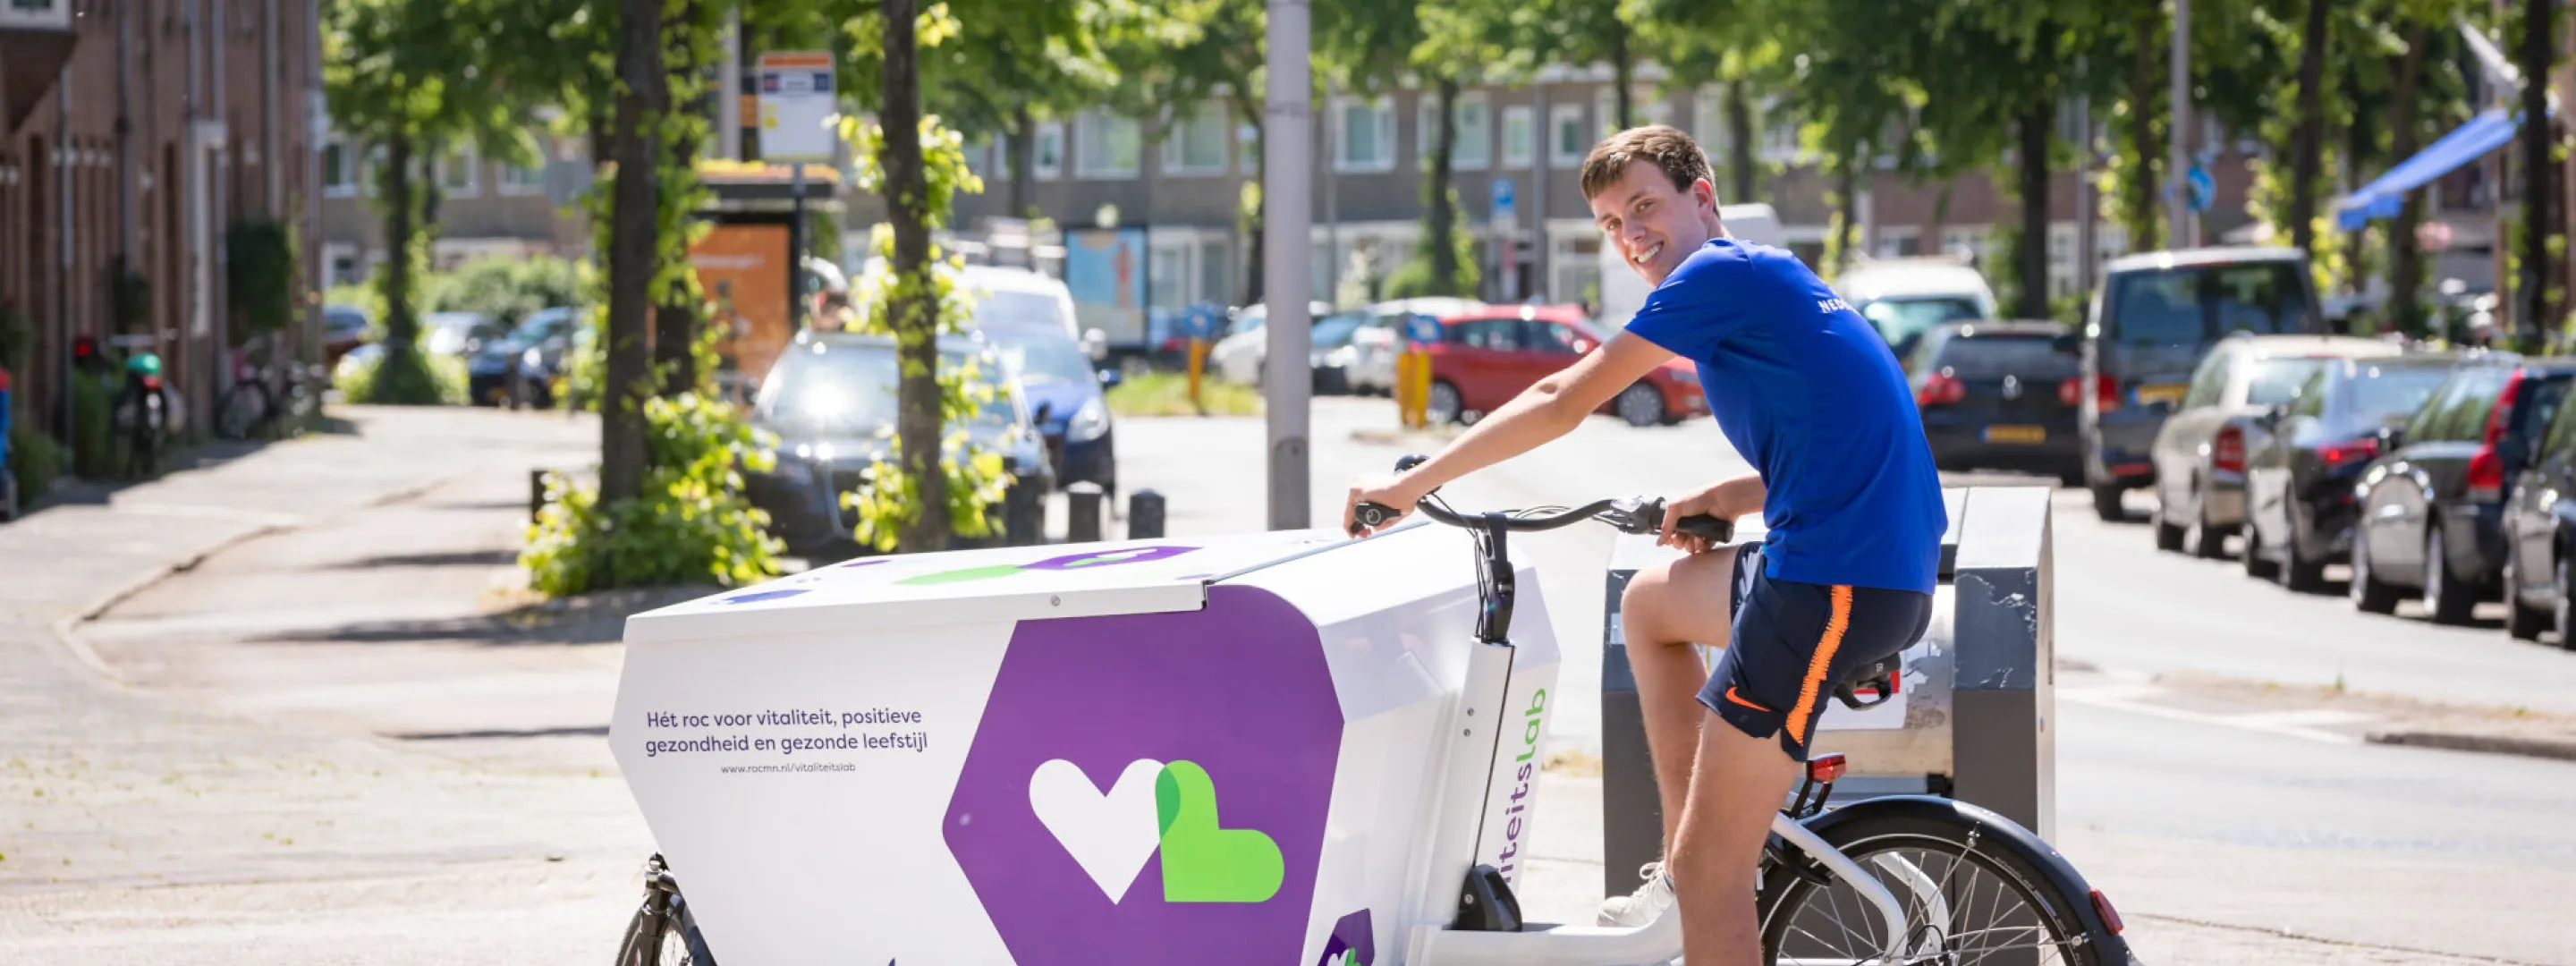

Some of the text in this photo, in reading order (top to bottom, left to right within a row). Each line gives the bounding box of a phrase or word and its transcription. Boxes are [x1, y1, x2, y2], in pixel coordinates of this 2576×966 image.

[648, 708, 921, 728] Hét roc voor vitaliteit, positieve
[646, 732, 928, 757] gezondheid en gezonde leefstijl
[721, 763, 856, 774] www.rocmn.nl/vitaliteitslab
